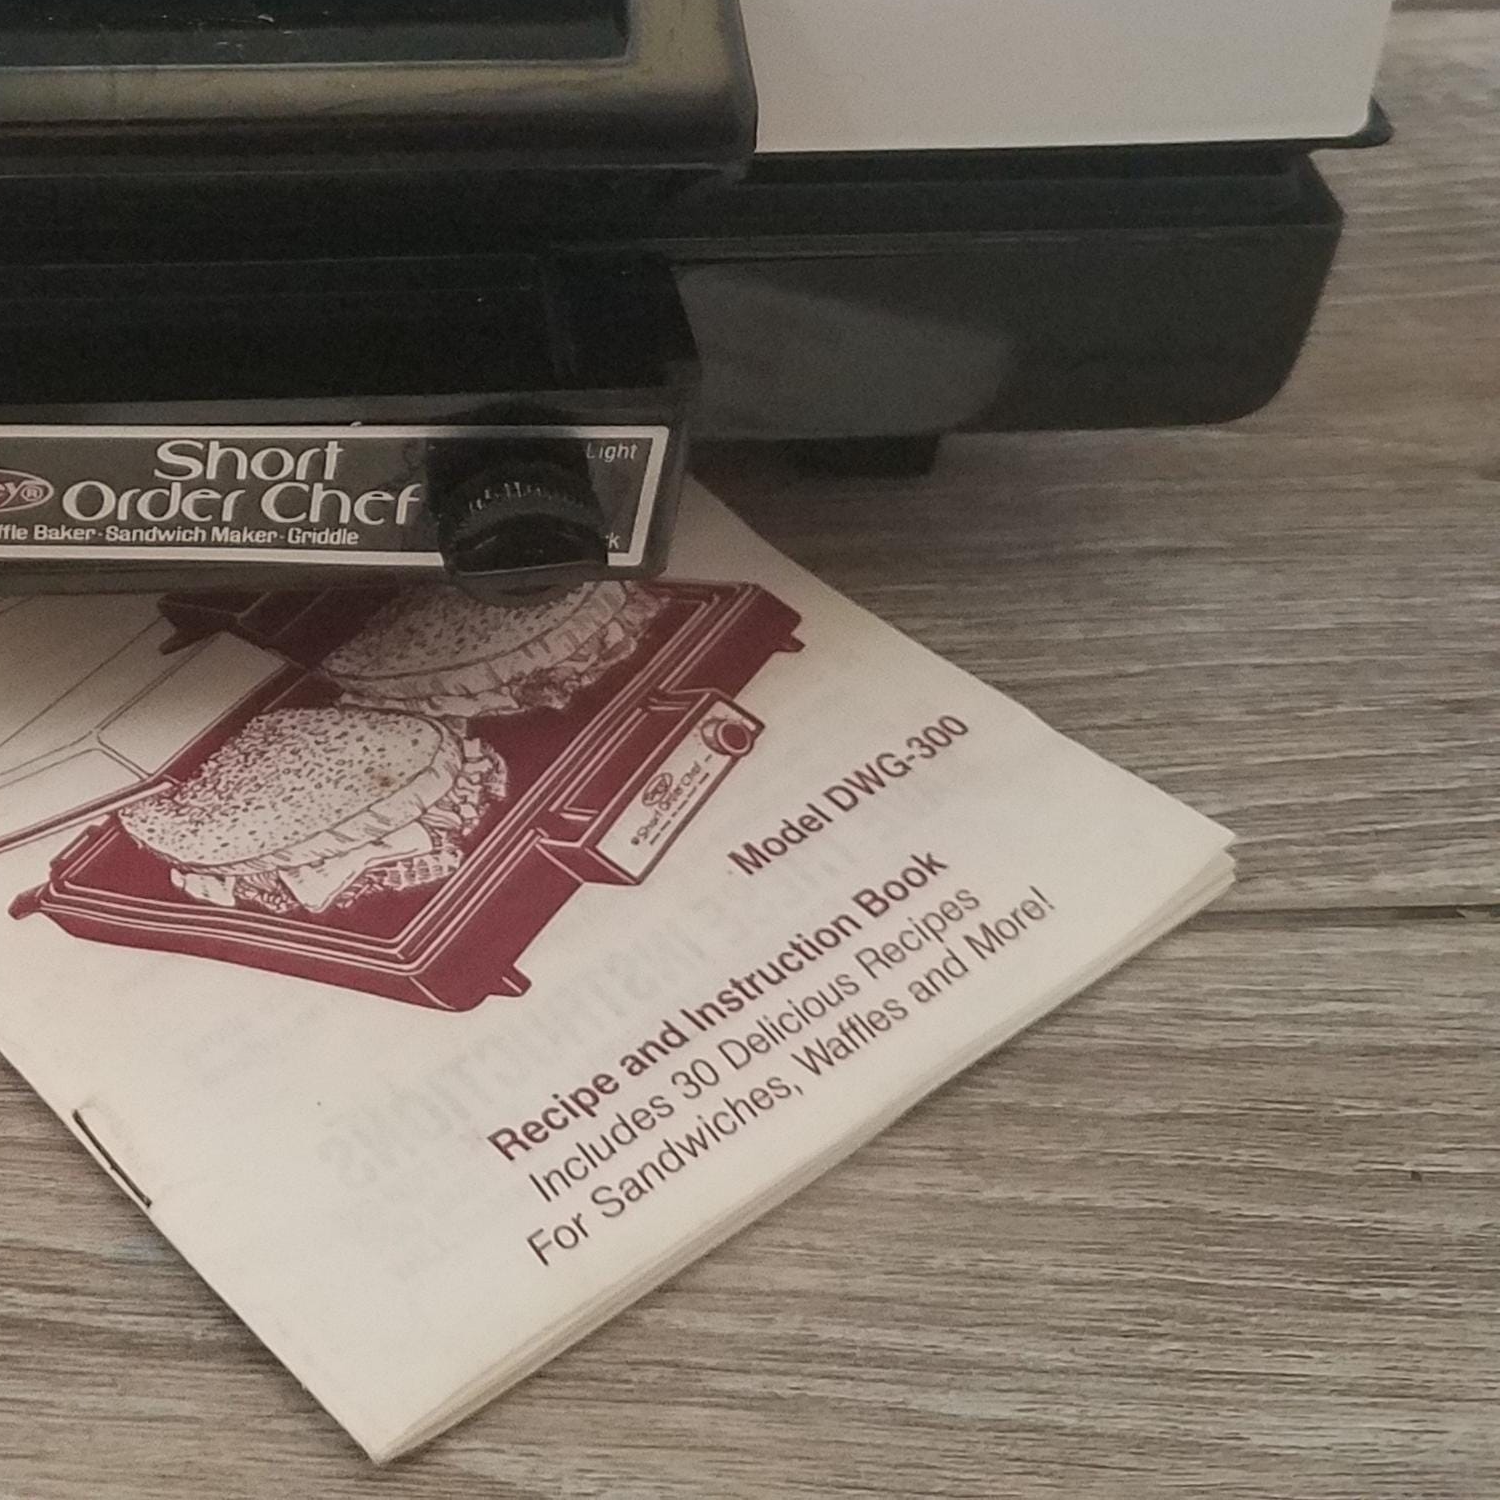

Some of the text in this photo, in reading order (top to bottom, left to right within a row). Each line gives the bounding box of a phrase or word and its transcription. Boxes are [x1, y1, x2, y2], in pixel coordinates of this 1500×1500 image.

[62, 480, 422, 525] Order Chef
[153, 438, 345, 482] Short
[586, 442, 639, 463] Light
[727, 714, 970, 876] Model DWG-300
[486, 1072, 621, 1162] Recipe
[619, 1019, 690, 1077] and
[679, 913, 863, 1032] Instruction
[852, 851, 950, 919] Book
[525, 884, 1056, 1267] For Sandwiches, Waffles and More!
[528, 1092, 675, 1203] Includes
[670, 1058, 720, 1100] 30
[717, 973, 861, 1071] Delicious
[854, 888, 981, 981] Recipes
